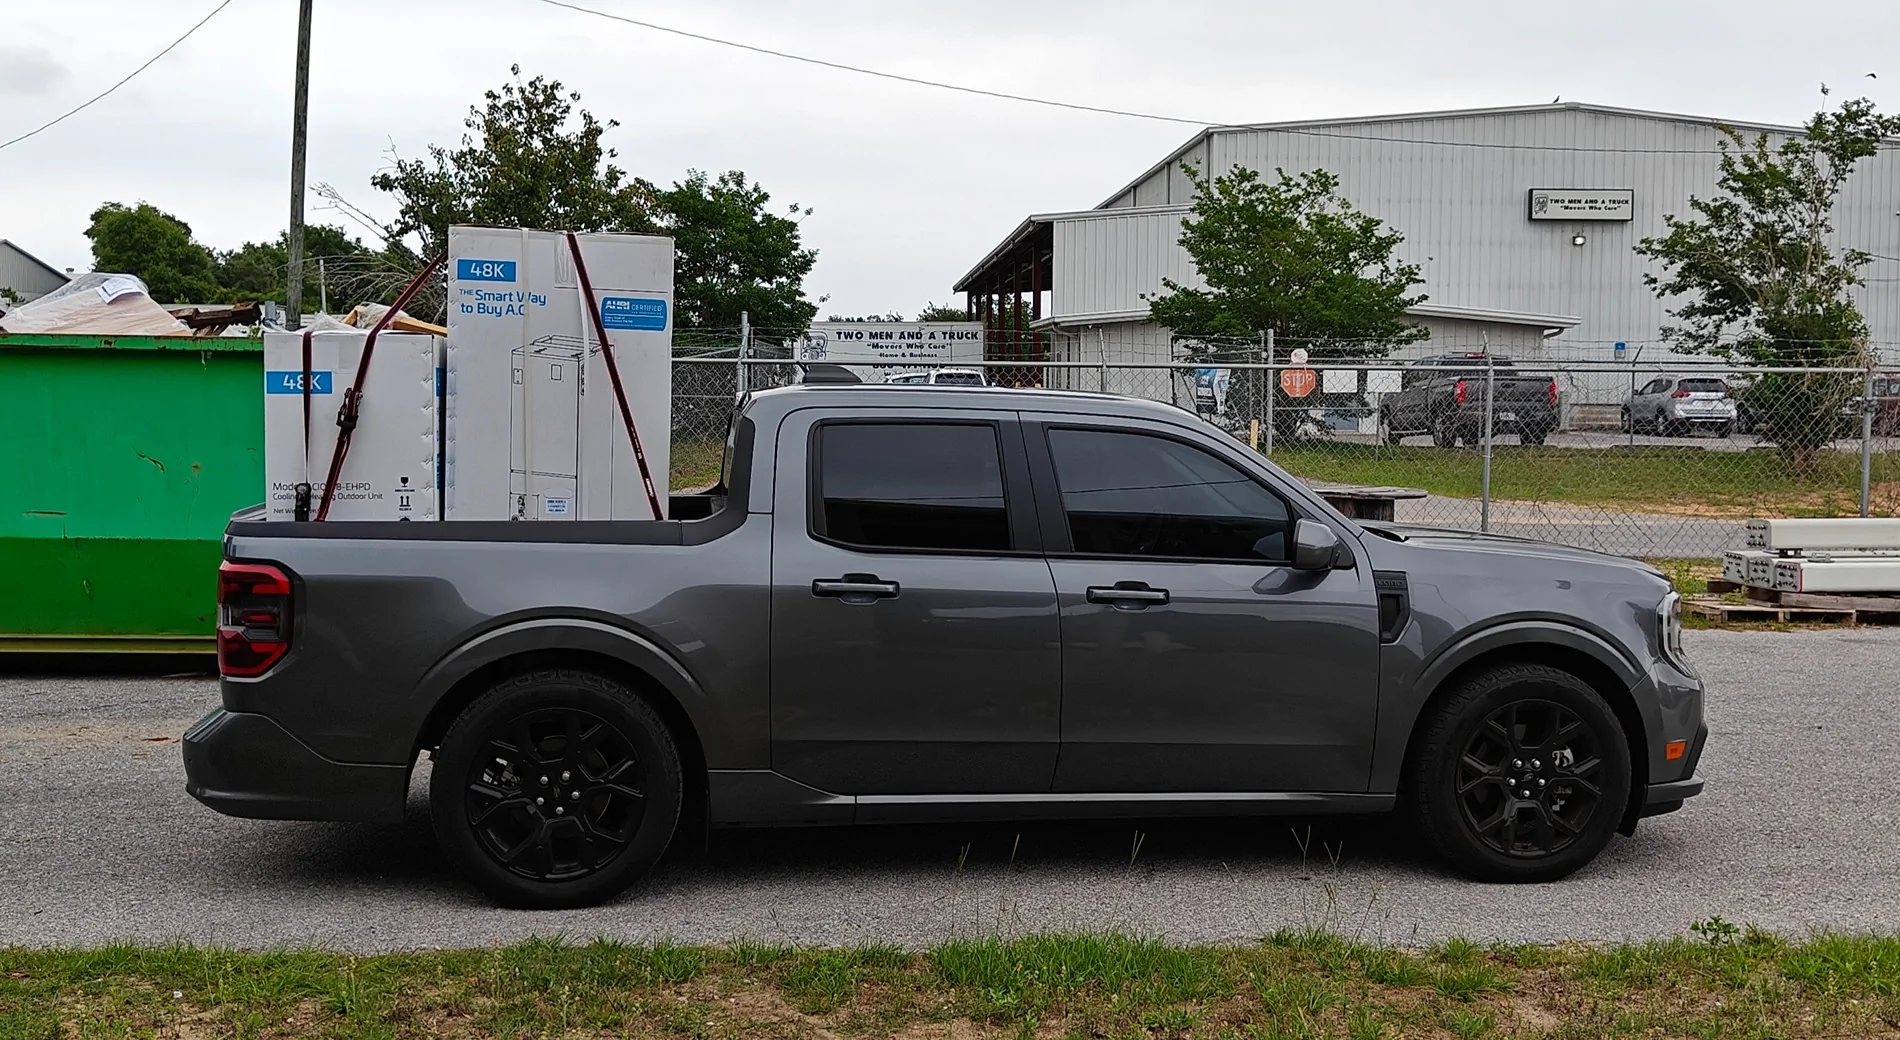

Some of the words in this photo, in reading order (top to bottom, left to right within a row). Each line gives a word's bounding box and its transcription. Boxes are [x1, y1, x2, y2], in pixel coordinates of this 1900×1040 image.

[470, 262, 504, 278] 48K
[475, 290, 514, 302] Smart
[461, 303, 474, 314] to
[478, 303, 502, 318] Buy
[836, 332, 864, 340] TWO
[283, 374, 321, 390] 48K
[1284, 374, 1312, 386] STOP
